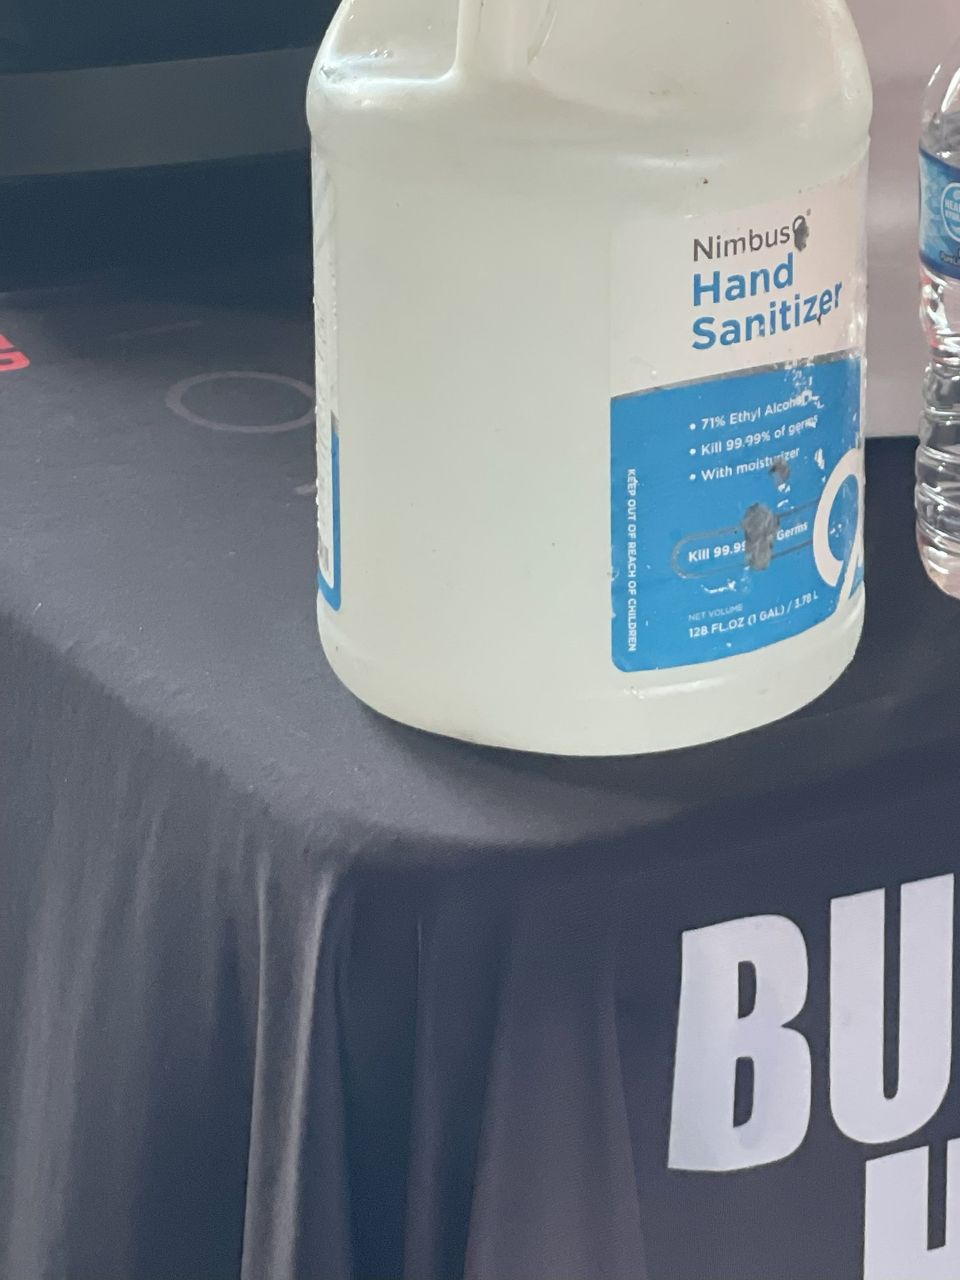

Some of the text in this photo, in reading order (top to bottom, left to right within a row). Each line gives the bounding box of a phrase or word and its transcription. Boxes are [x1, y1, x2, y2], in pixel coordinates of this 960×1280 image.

[693, 229, 790, 262] Nimbus
[693, 252, 793, 306] Hand
[692, 281, 842, 351] Sanitizer
[701, 415, 726, 431] 71%
[729, 407, 761, 425] Ethyl
[701, 441, 722, 456] Kill
[726, 431, 771, 451] 99.99%
[774, 425, 786, 439] of
[701, 465, 732, 481] With
[627, 468, 638, 652] KEEP OUT OF REACH OF CHILDREN
[688, 548, 710, 563] Kill
[776, 522, 808, 541] Germs
[688, 603, 744, 622] NET VOLUME
[688, 626, 709, 639] 128
[759, 605, 786, 622] GAL)
[794, 592, 812, 609] 3.78
